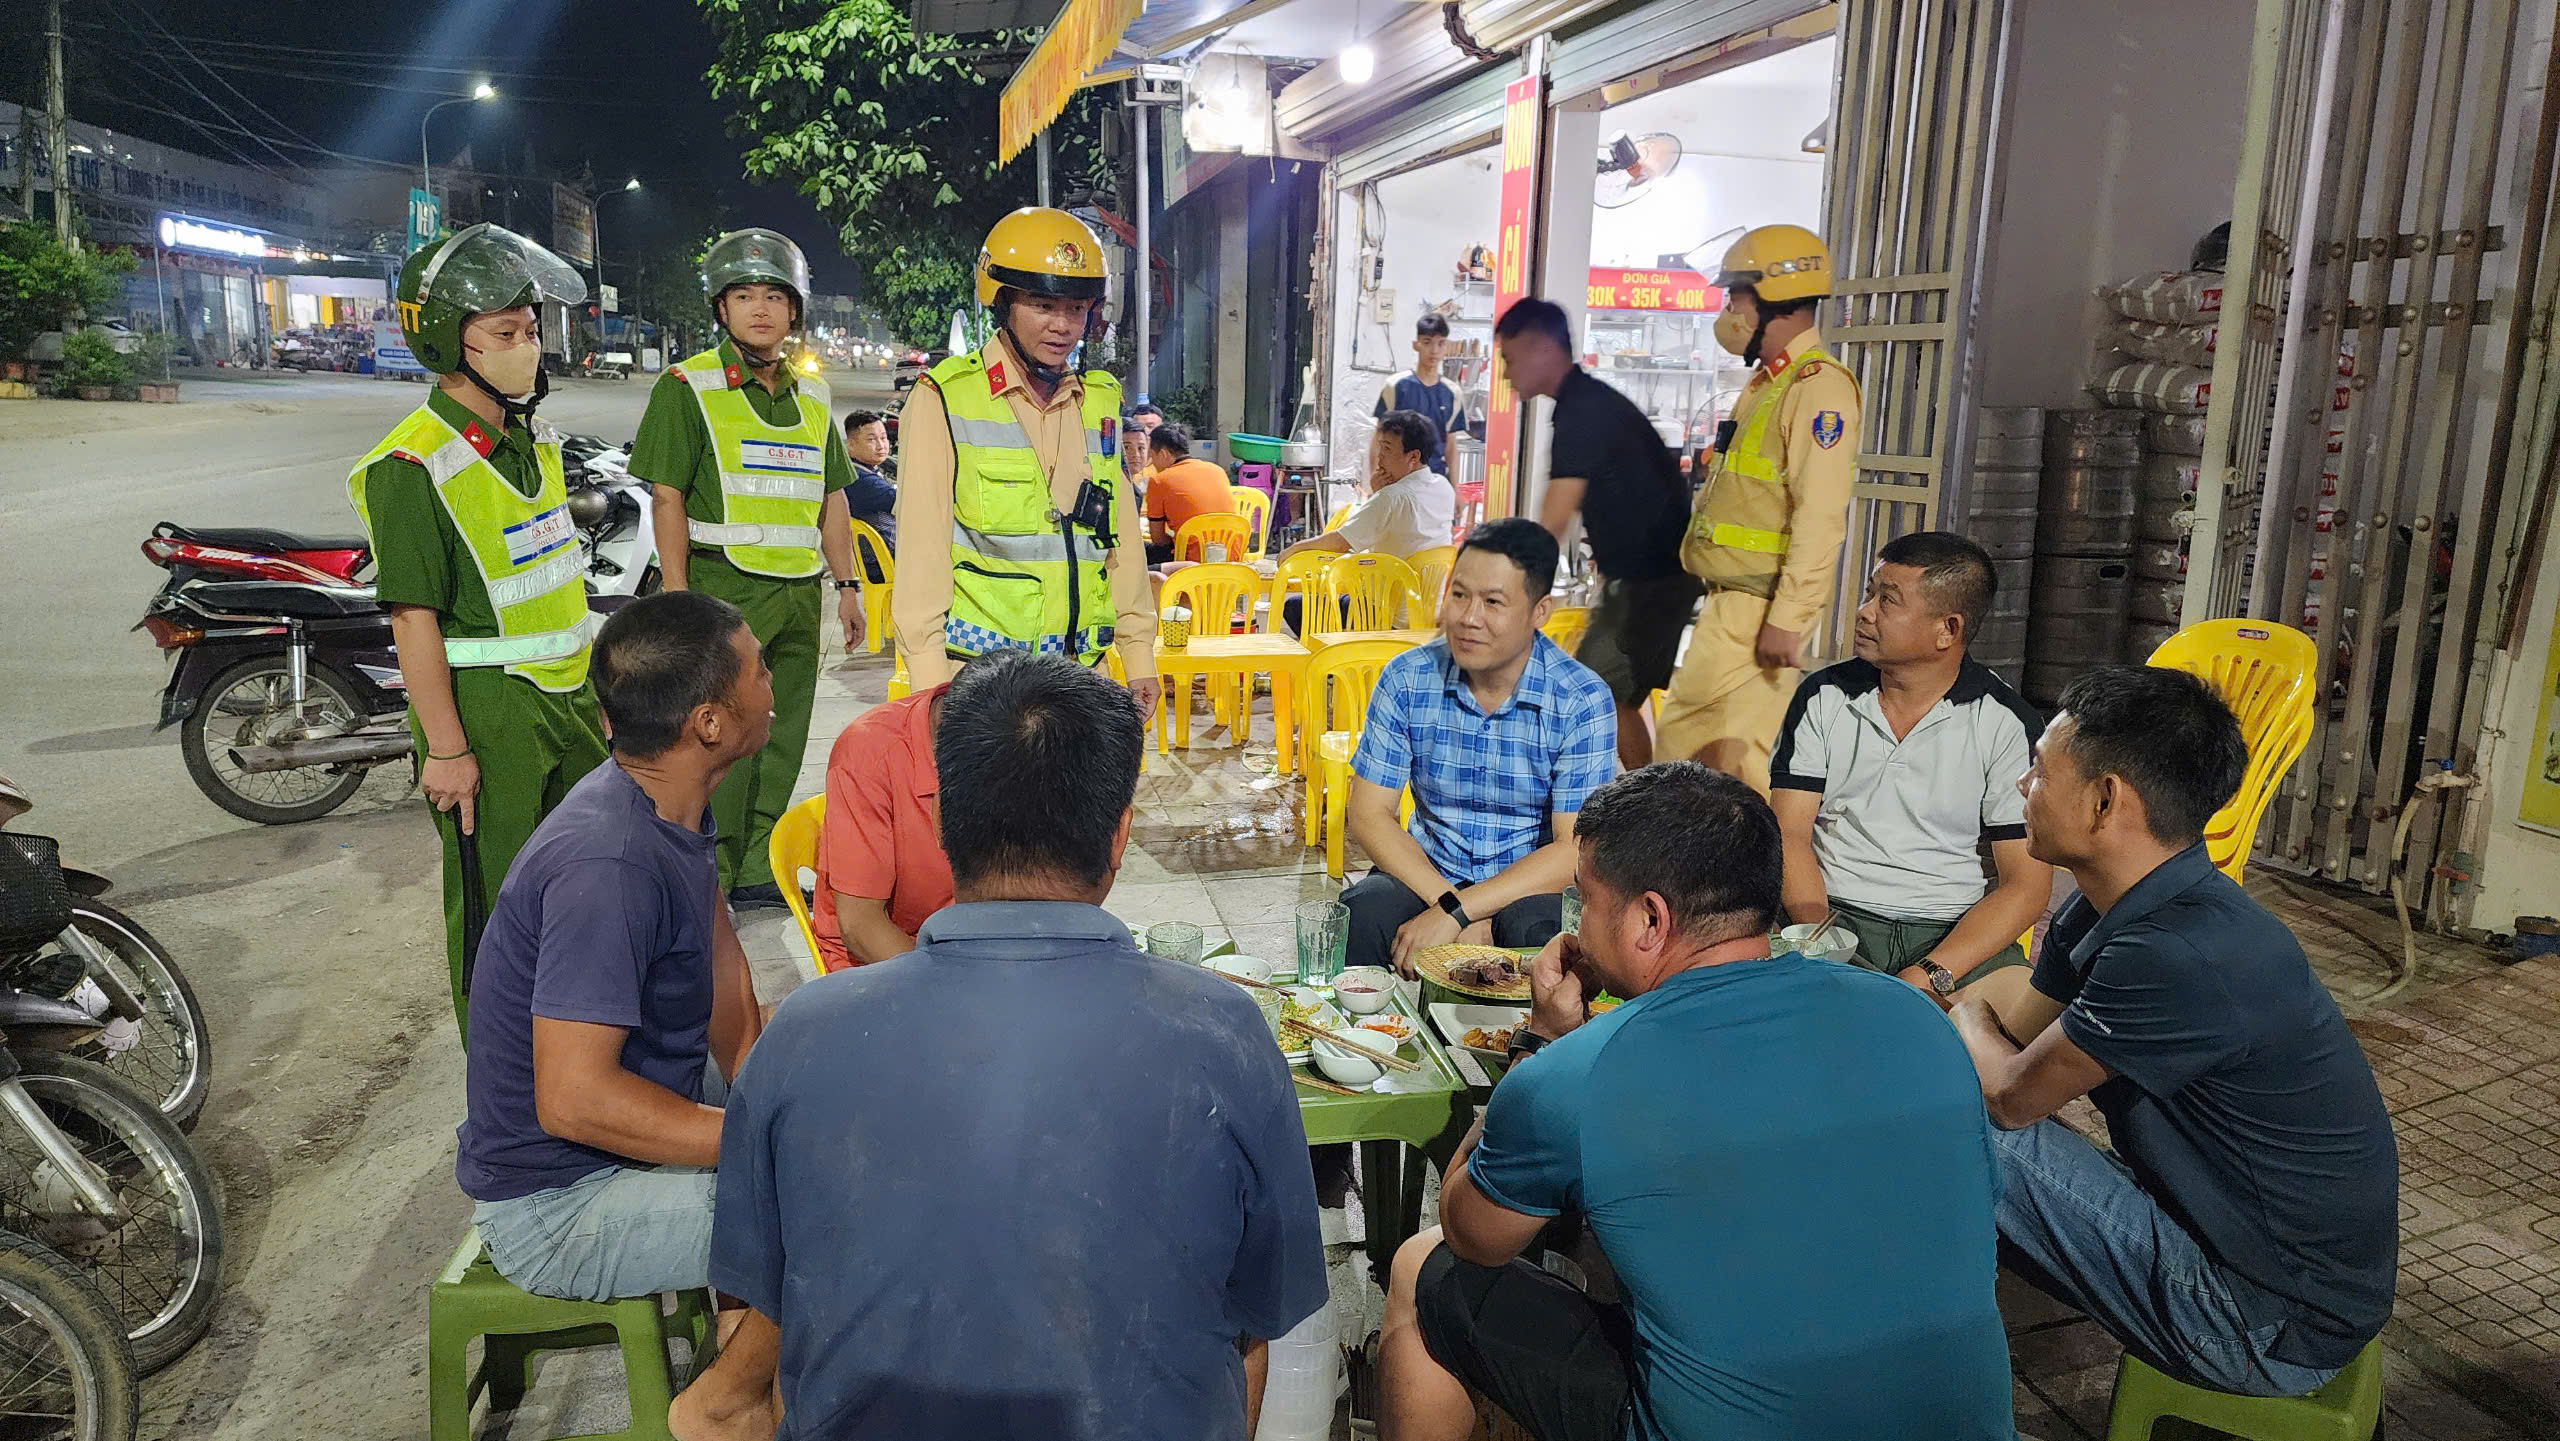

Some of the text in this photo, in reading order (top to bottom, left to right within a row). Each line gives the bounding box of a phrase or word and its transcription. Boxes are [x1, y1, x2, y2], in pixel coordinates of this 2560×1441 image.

[1504, 84, 1534, 174] BÚN
[1502, 208, 1521, 295] CÁ
[1623, 272, 1671, 285] ĐƠN GIÁ
[1586, 285, 1616, 307] 30K
[1630, 287, 1661, 308] 35K
[1676, 289, 1705, 310] 40K
[768, 447, 804, 460] C.S.G.T
